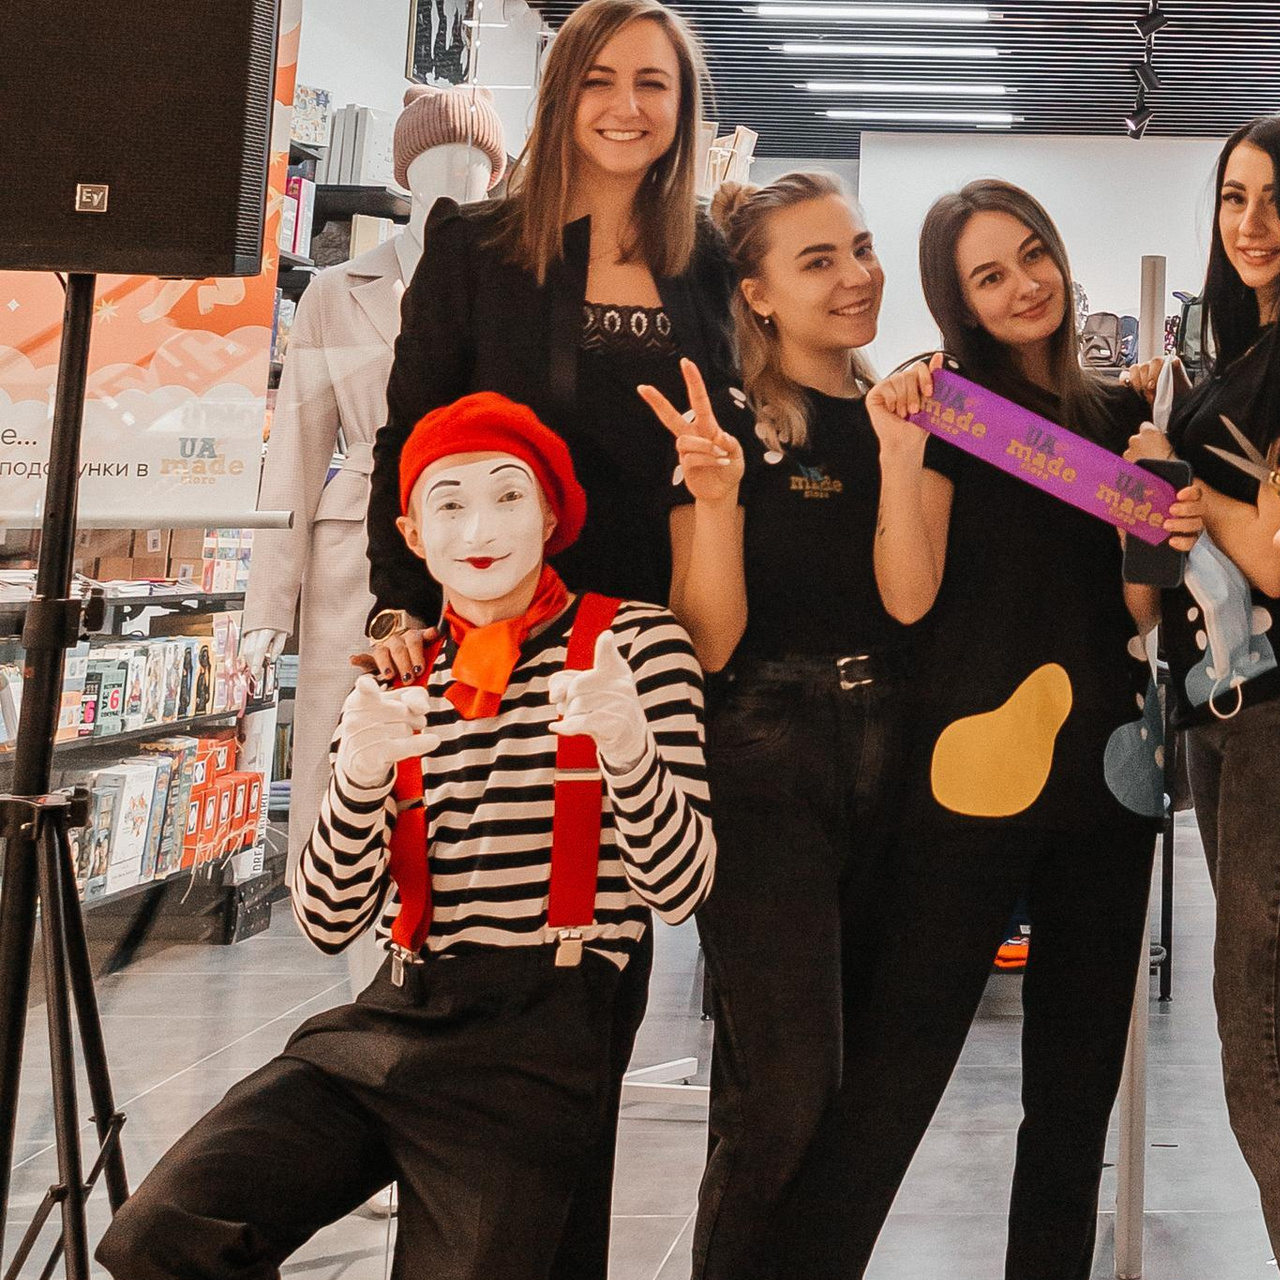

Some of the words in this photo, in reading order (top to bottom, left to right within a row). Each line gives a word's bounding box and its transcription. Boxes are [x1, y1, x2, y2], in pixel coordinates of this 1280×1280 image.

[160, 454, 244, 475] made
[178, 437, 217, 459] UA
[1005, 438, 1077, 483] made
[1096, 483, 1164, 528] made
